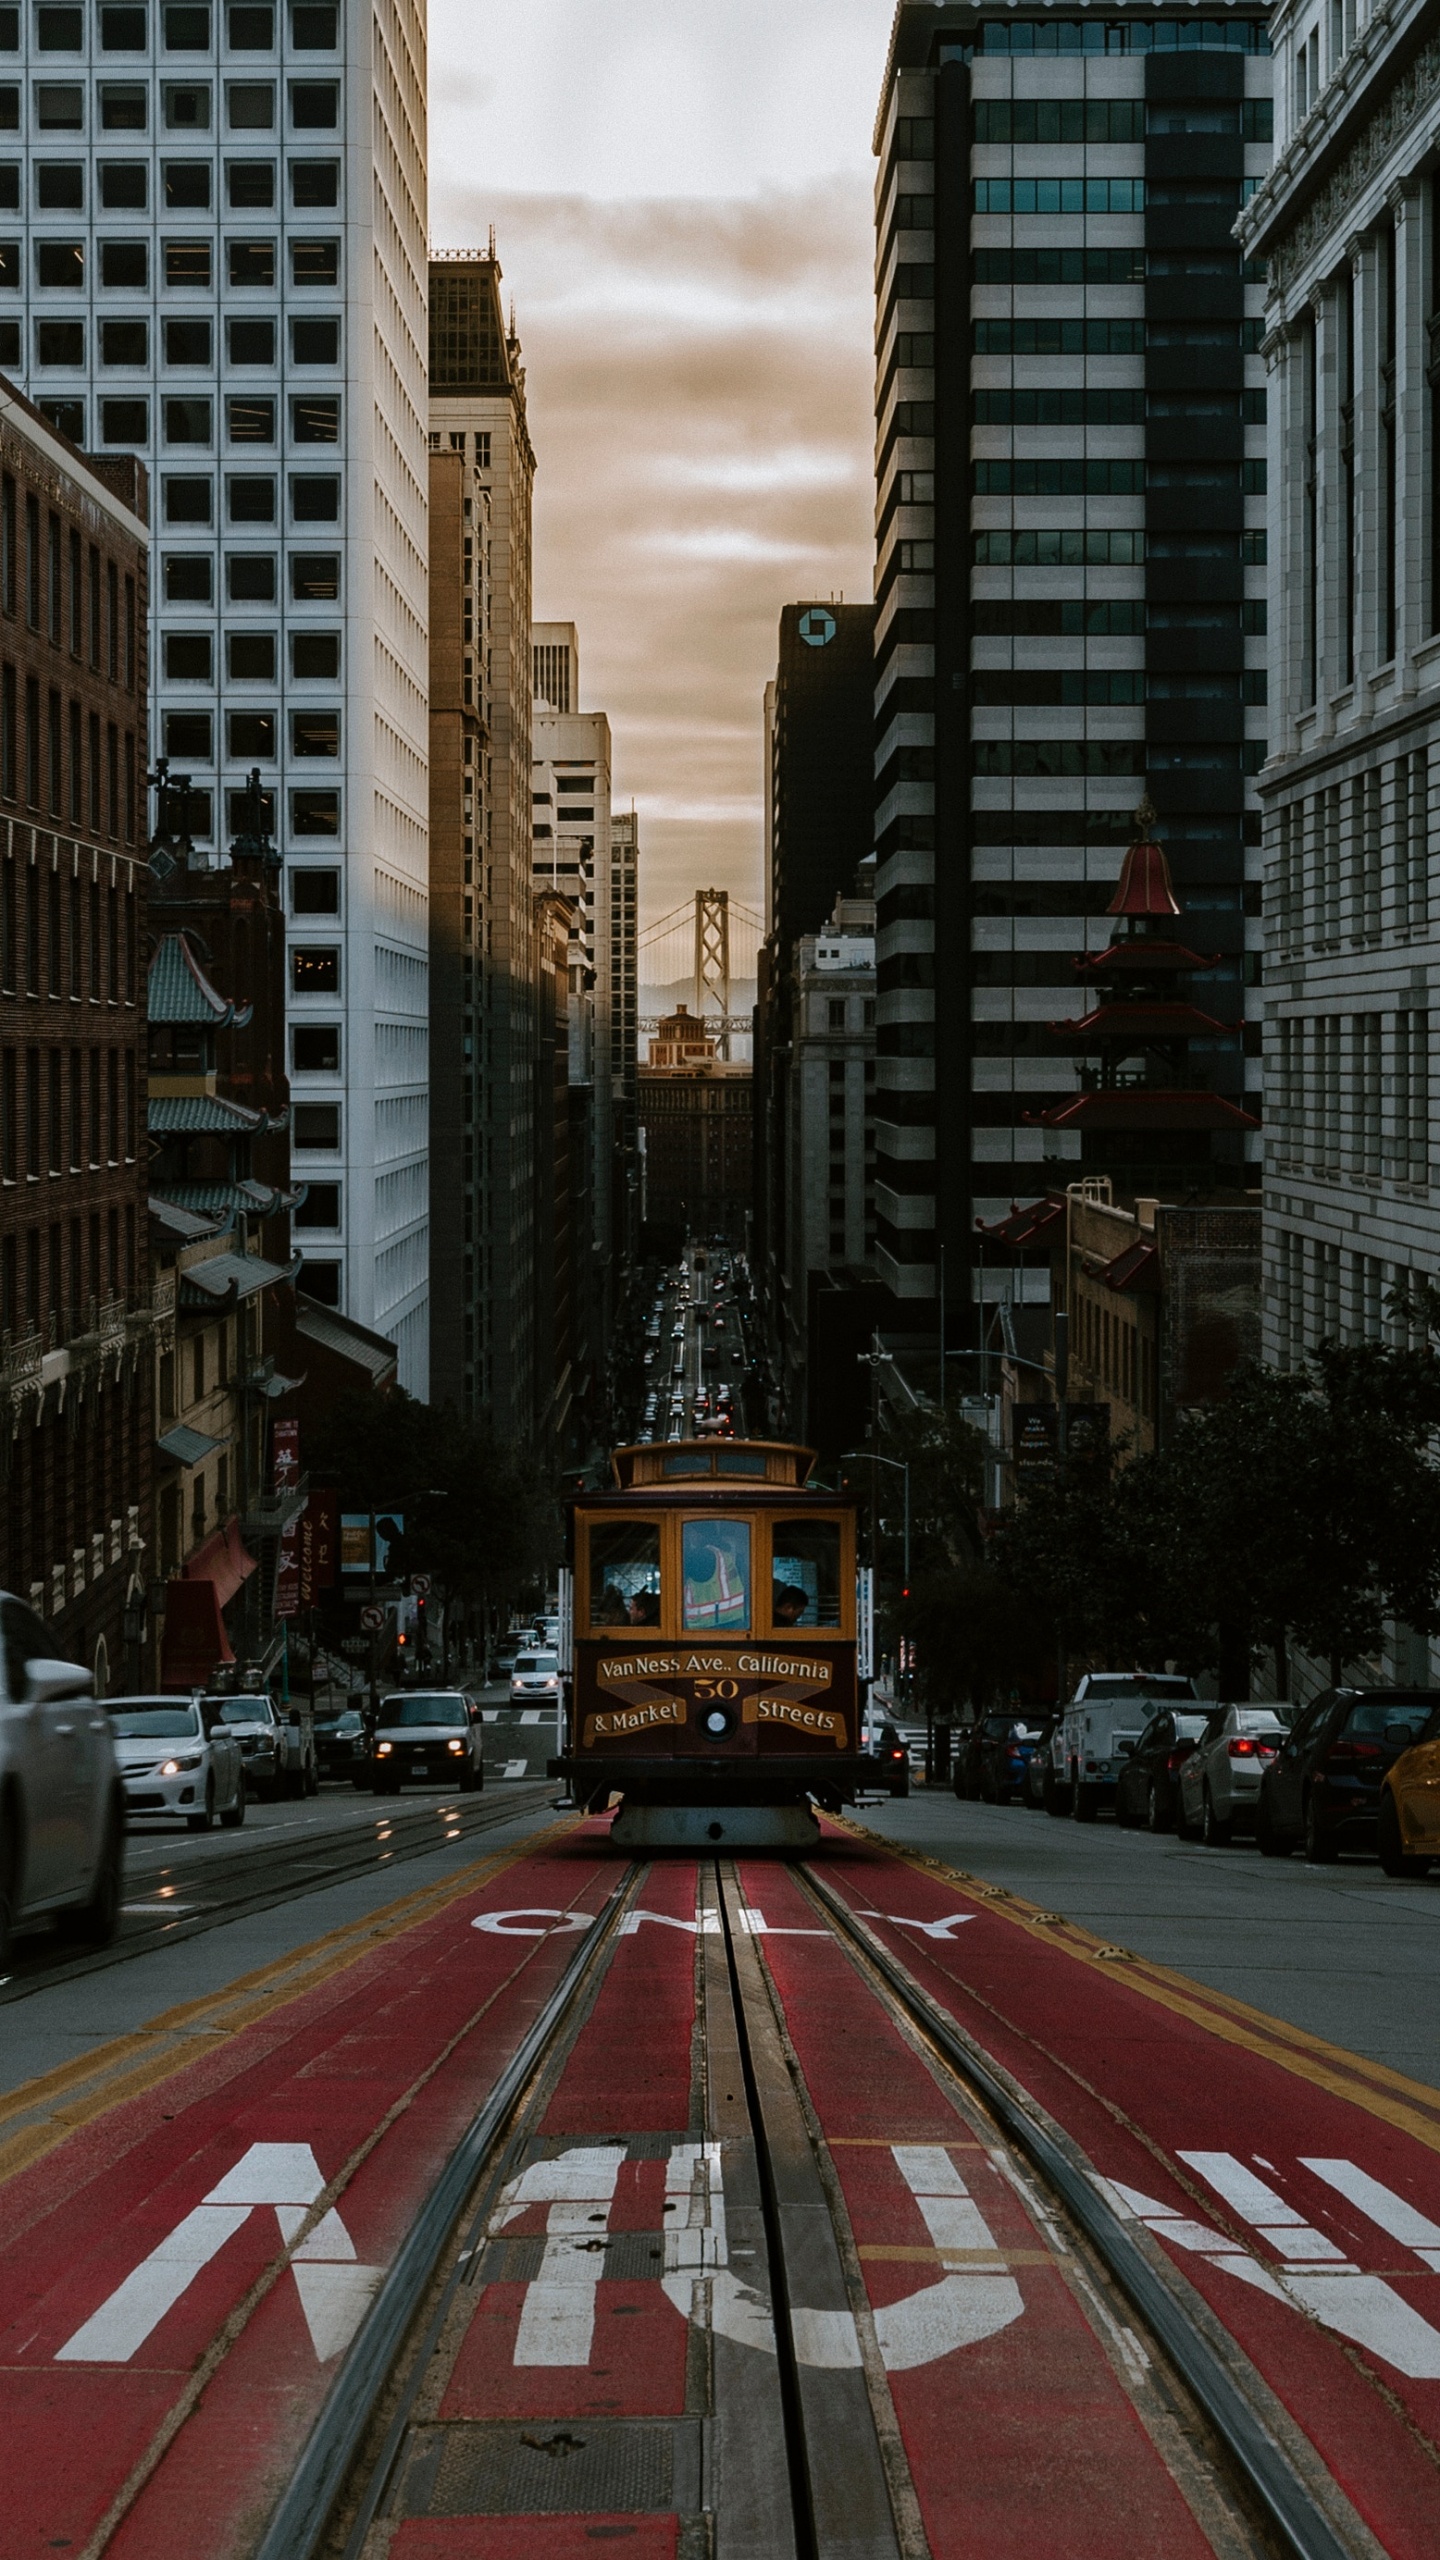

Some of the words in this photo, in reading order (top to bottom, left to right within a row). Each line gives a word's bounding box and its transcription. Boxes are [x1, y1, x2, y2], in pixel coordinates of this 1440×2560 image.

[602, 1661, 633, 1678] Van
[635, 1657, 680, 1674] Ness
[738, 1655, 829, 1680] California
[693, 1679, 739, 1699] 50
[594, 1715, 608, 1732] &
[612, 1702, 678, 1730] Market
[758, 1700, 836, 1730] Streets
[470, 1908, 978, 1940] ONLY
